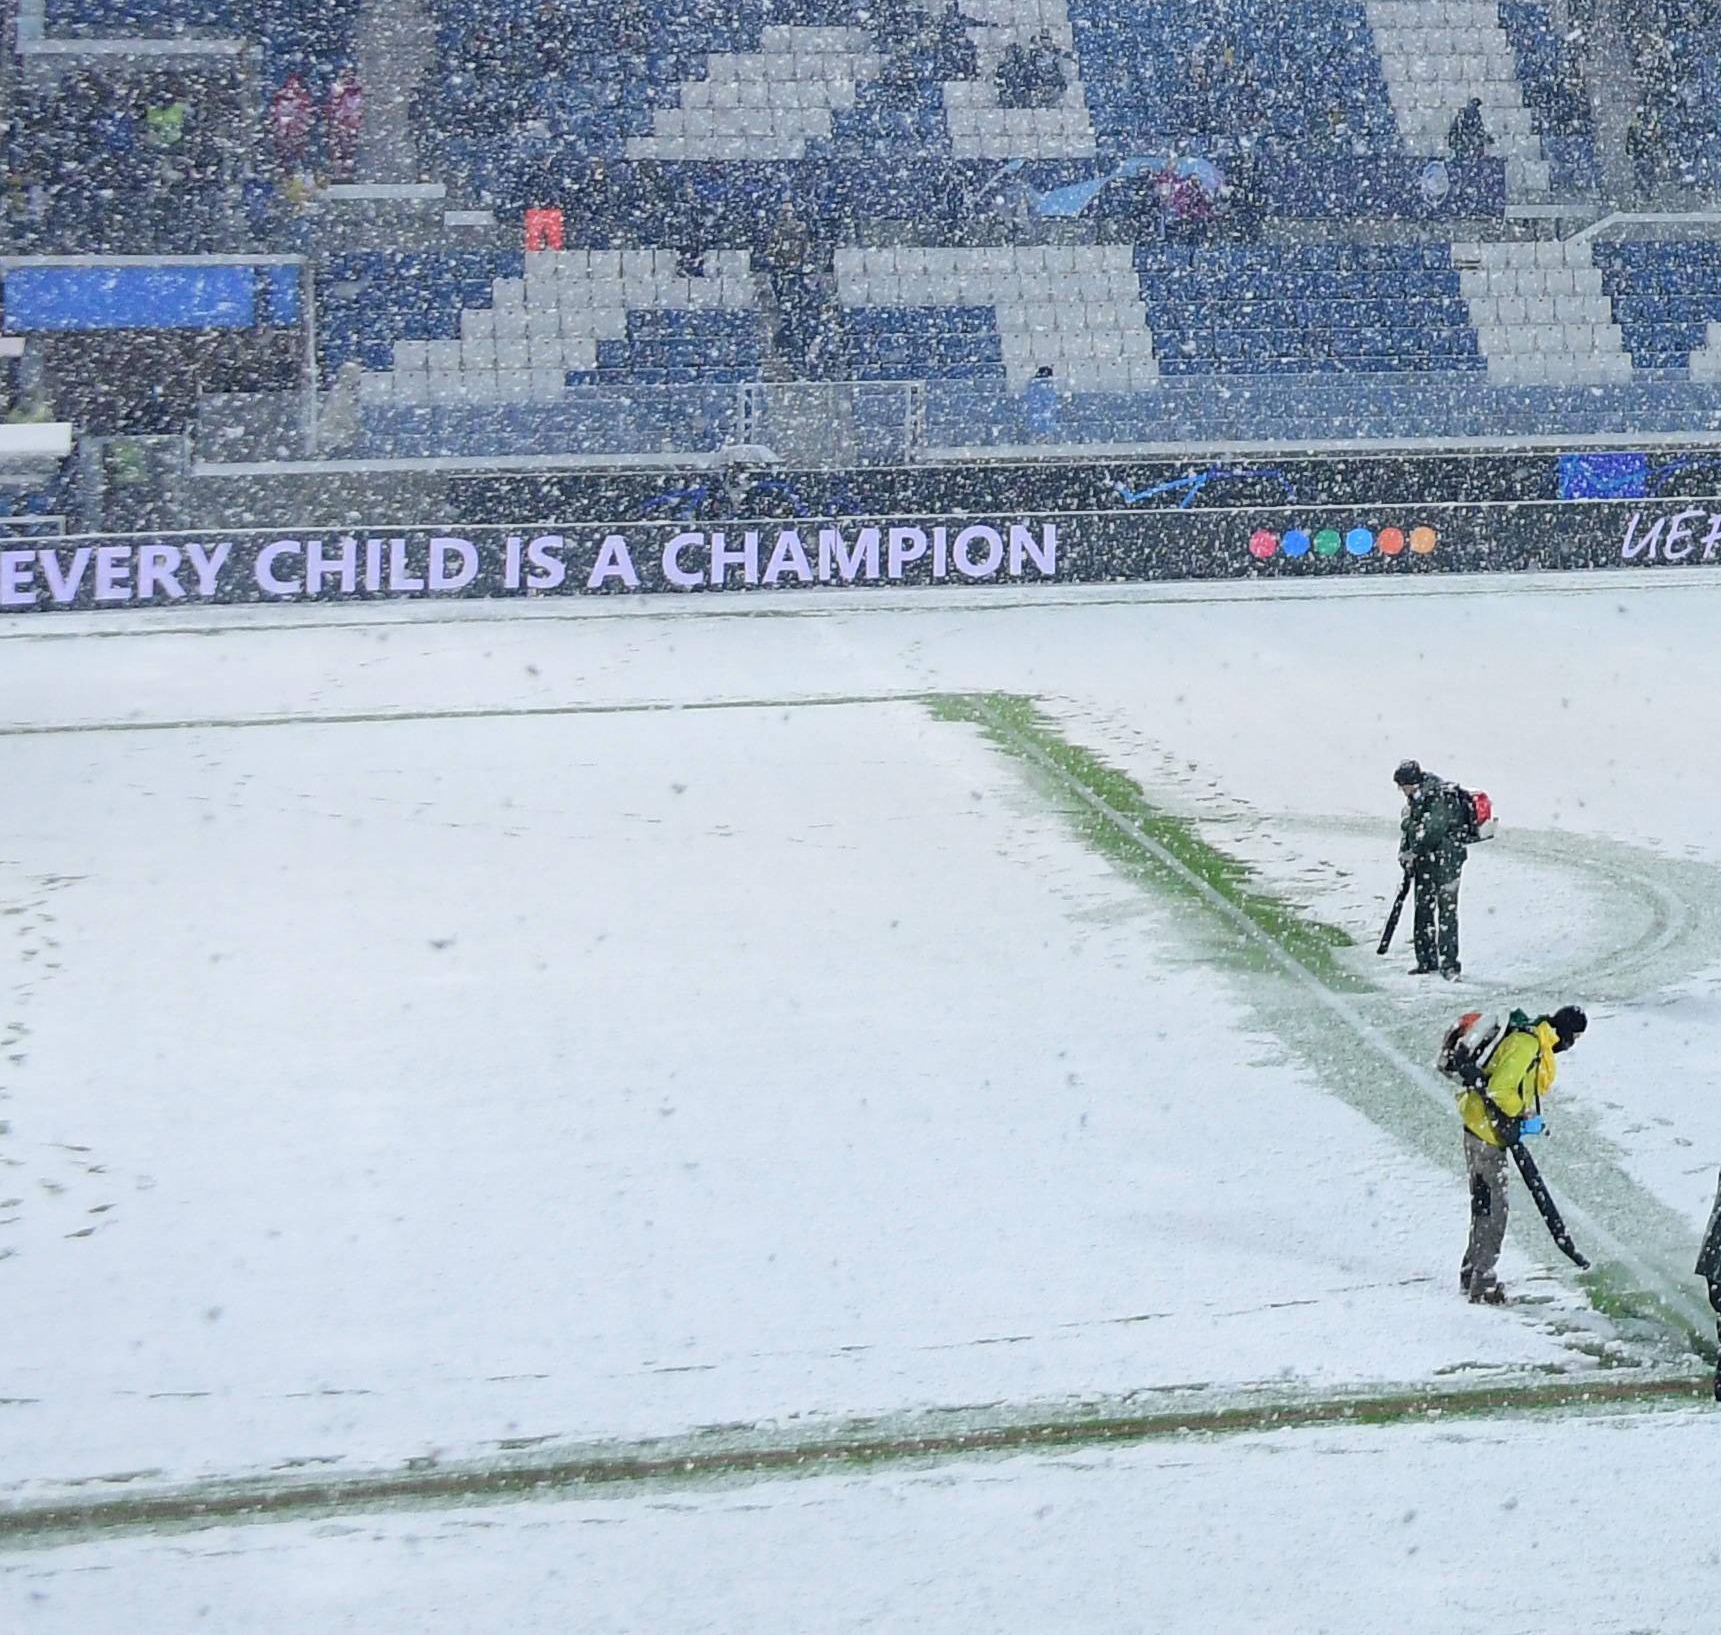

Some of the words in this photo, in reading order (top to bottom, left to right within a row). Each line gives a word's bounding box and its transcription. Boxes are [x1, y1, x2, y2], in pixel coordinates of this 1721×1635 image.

[0, 542, 233, 605] EVERY
[254, 536, 480, 595] CHILD
[503, 534, 565, 589] IS
[586, 535, 640, 586] A
[661, 523, 1057, 585] CHAMPION
